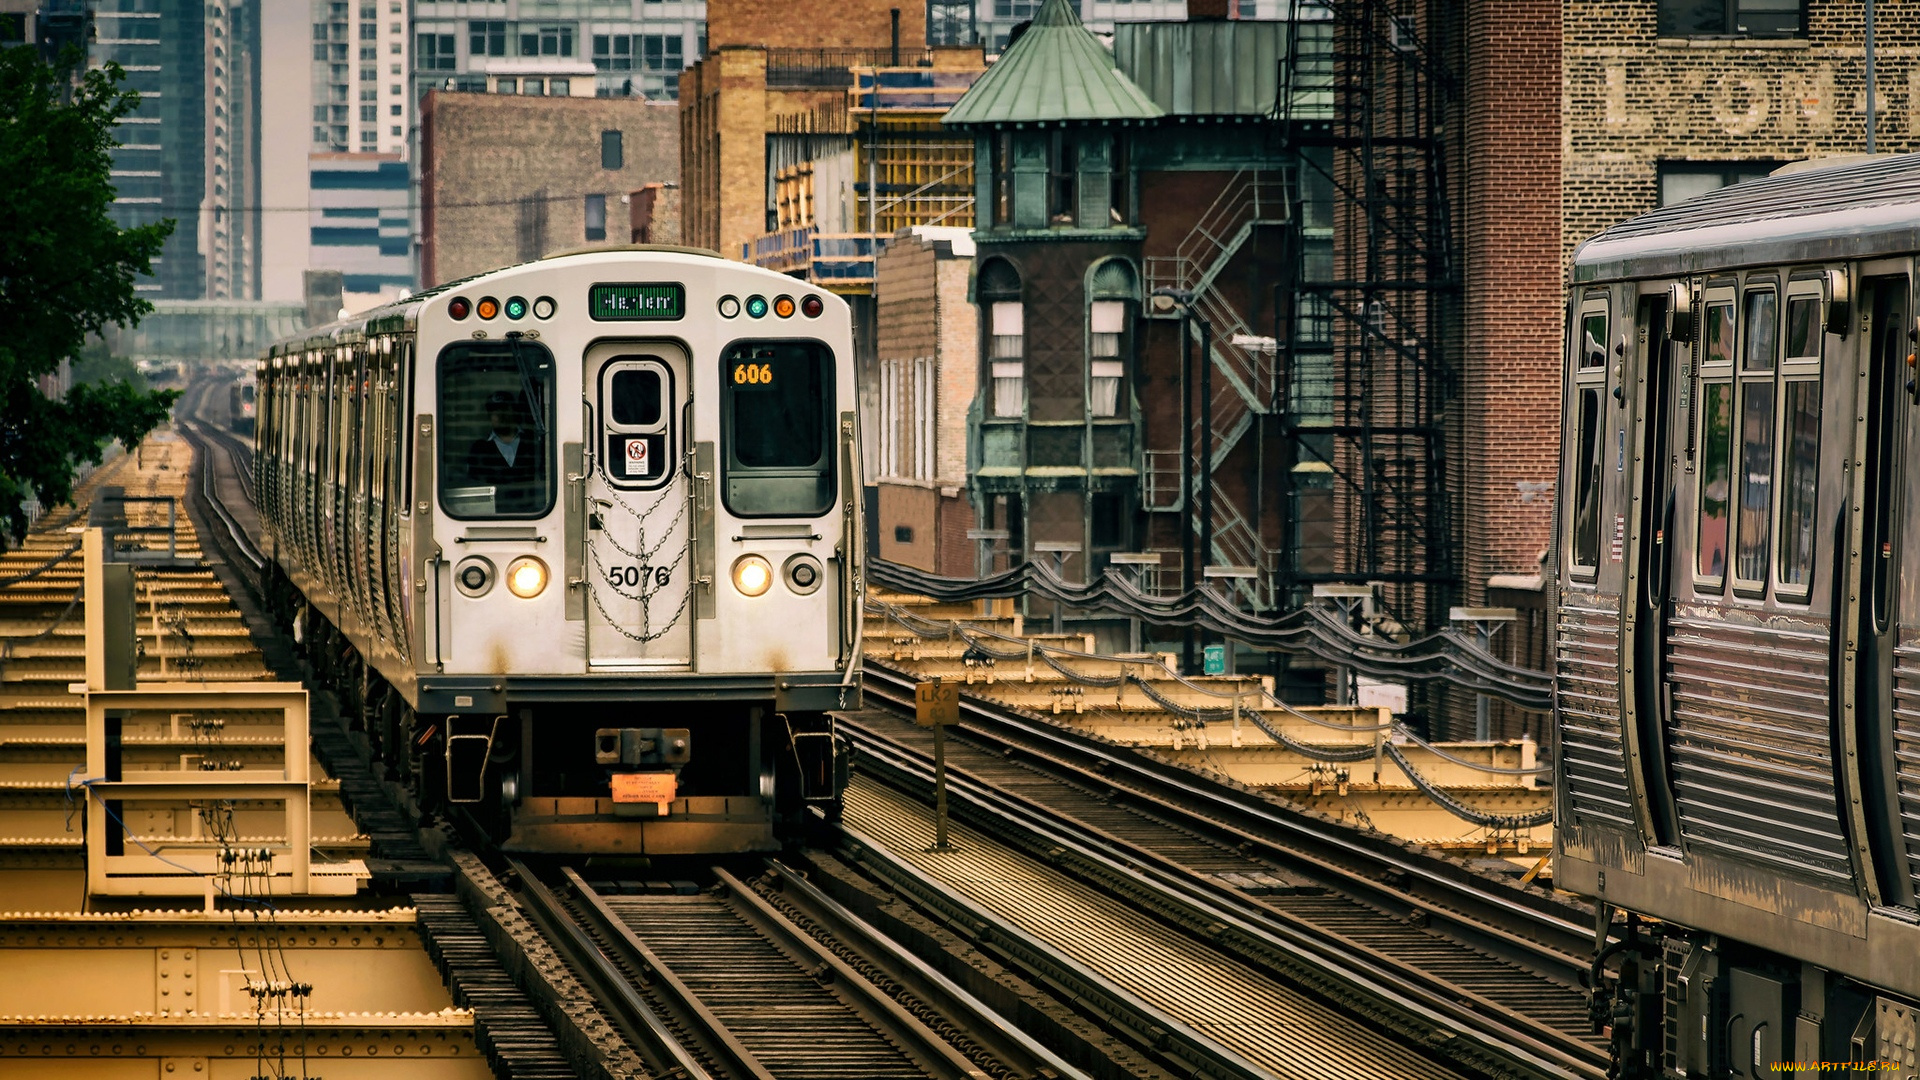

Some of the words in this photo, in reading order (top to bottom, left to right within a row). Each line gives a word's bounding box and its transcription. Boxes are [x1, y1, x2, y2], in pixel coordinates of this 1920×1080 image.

[734, 363, 772, 384] 606
[609, 566, 670, 587] 5076
[922, 689, 952, 702] LK2
